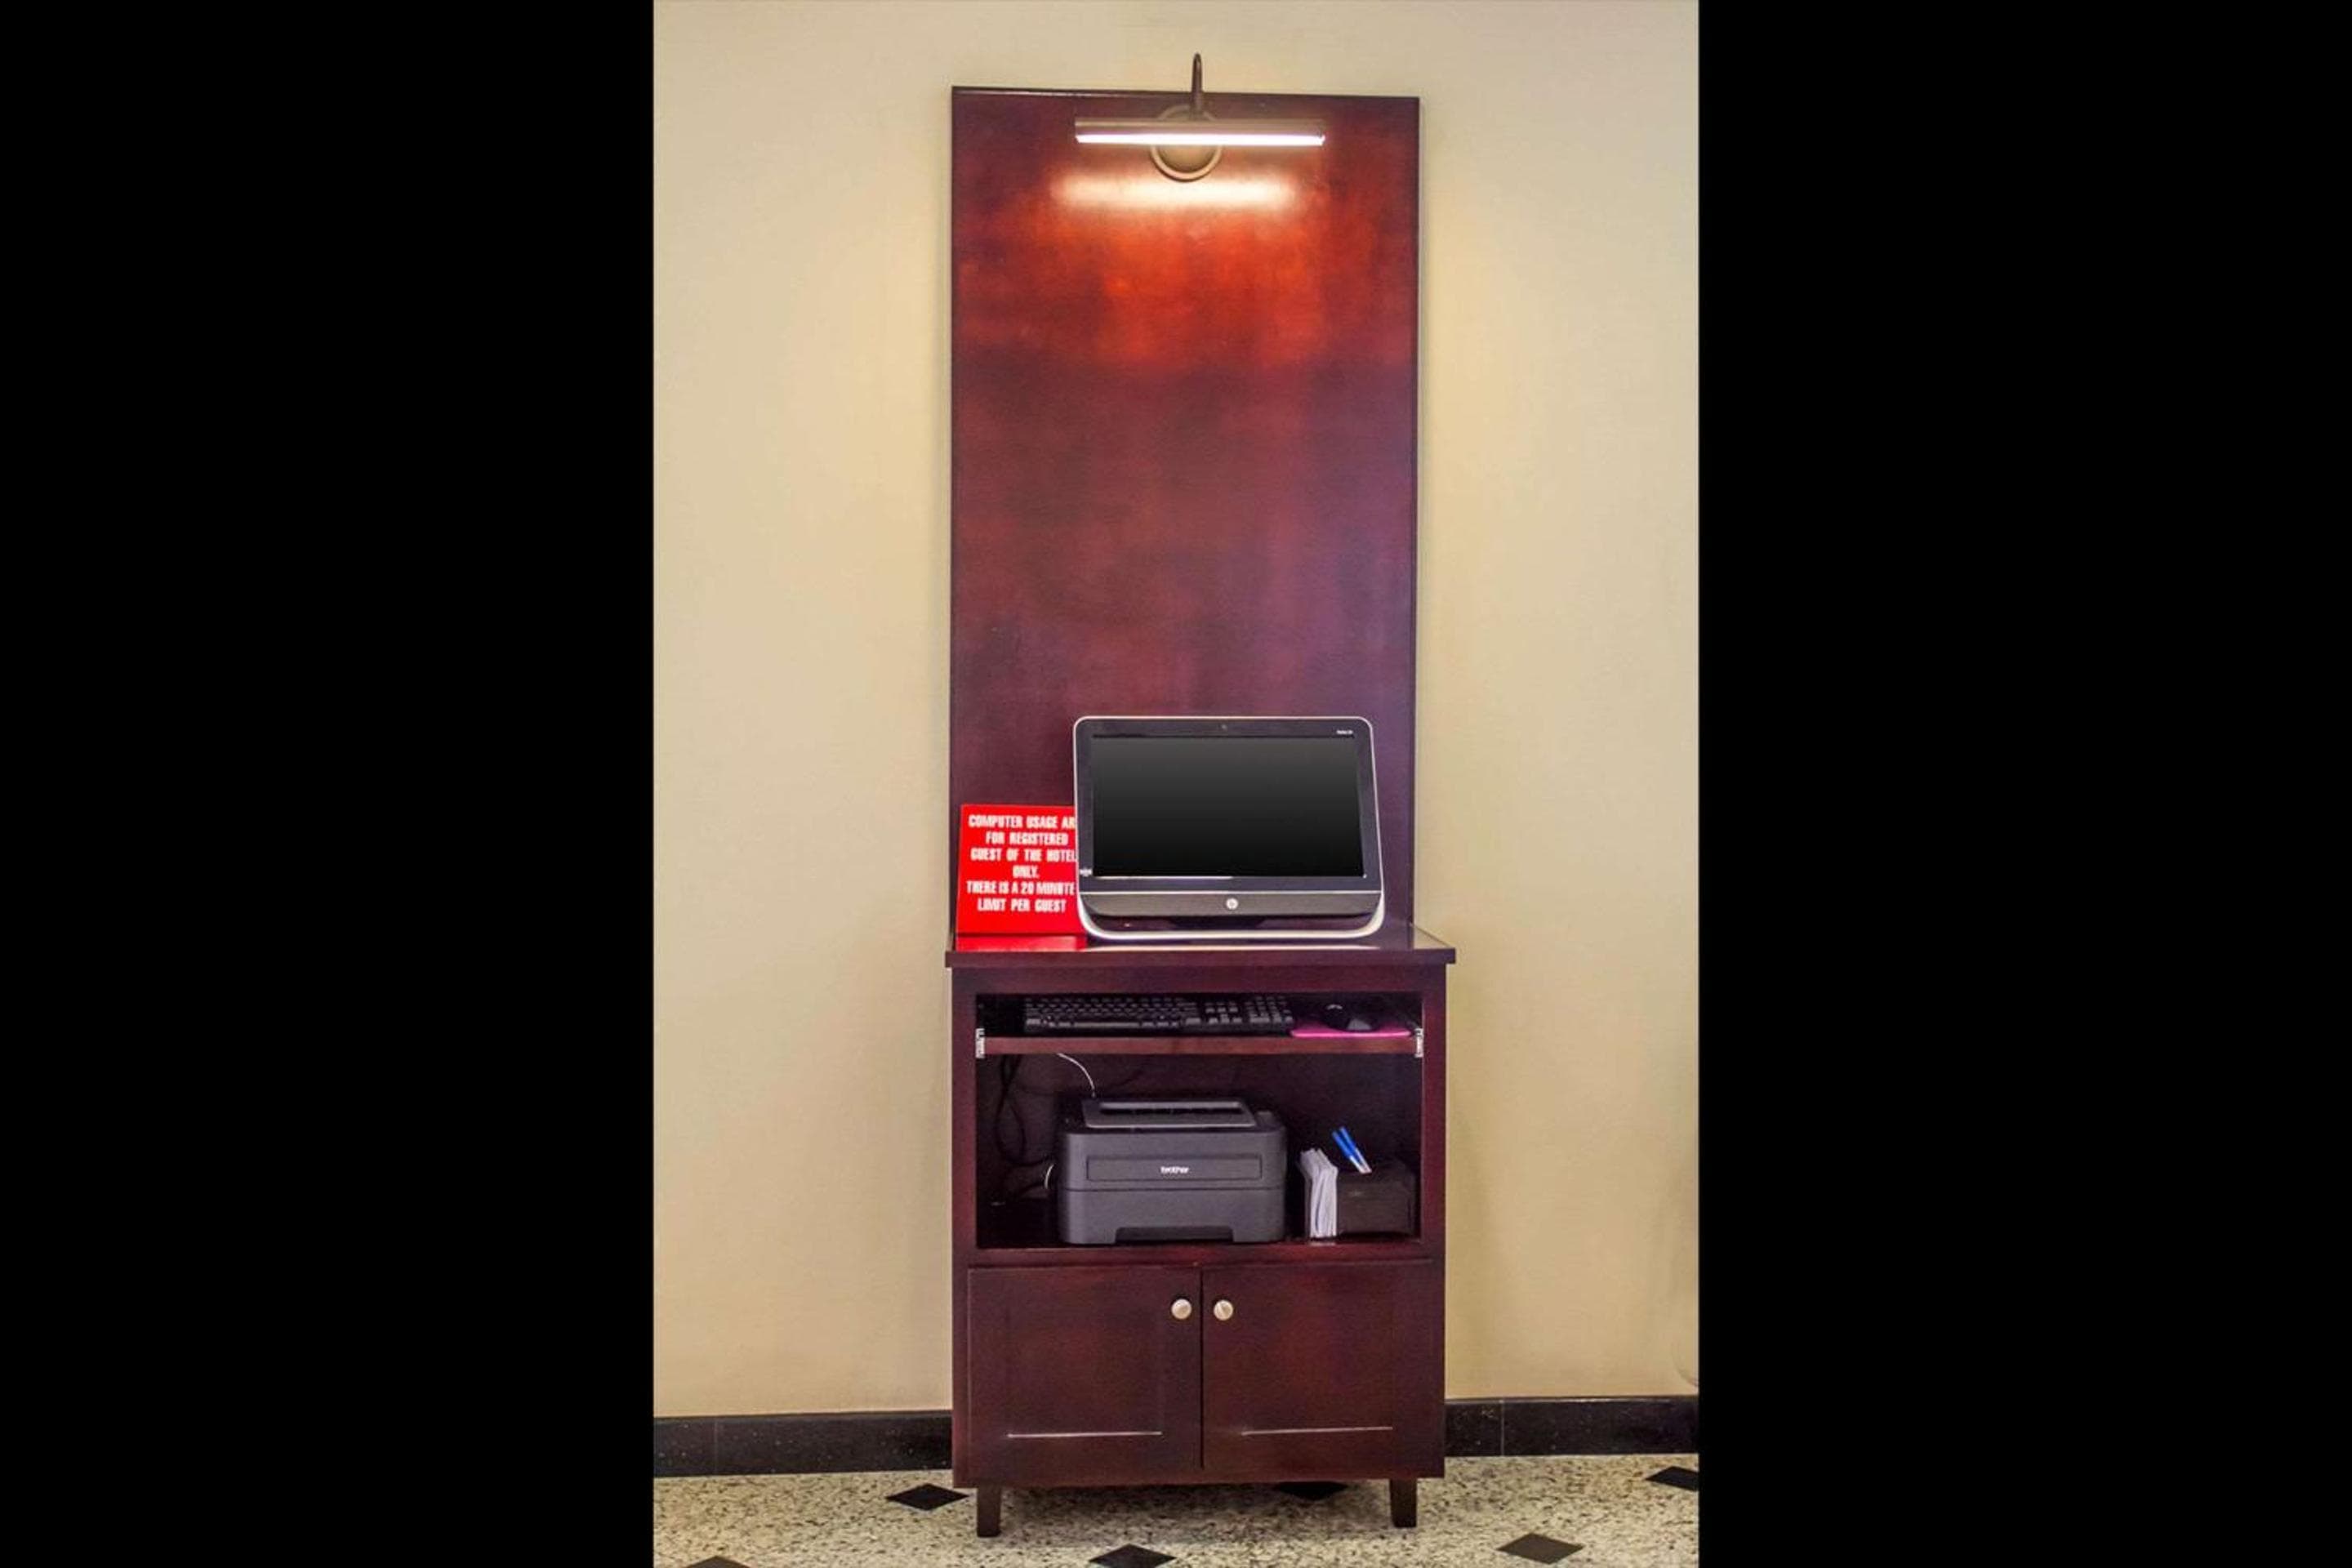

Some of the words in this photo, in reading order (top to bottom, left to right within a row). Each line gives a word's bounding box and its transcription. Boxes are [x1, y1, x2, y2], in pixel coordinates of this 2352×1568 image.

[969, 815, 1023, 828] COMPUTER
[1027, 816, 1058, 829] USAGE
[986, 831, 1005, 844] FOR
[1009, 832, 1069, 846] REGISTERED
[970, 848, 1002, 861] GUEST
[1006, 849, 1018, 861] OF
[1024, 849, 1042, 862] THE
[1046, 849, 1077, 862] HOTEL
[1013, 865, 1040, 878] ONLY.
[967, 881, 996, 893] THERE
[999, 882, 1009, 894] IS
[1011, 882, 1018, 894] A
[1021, 882, 1035, 894] 20
[1036, 882, 1076, 895] MINUTE
[978, 898, 1007, 911] LIMIT
[1011, 899, 1030, 911] PER
[1035, 899, 1067, 912] GUEST
